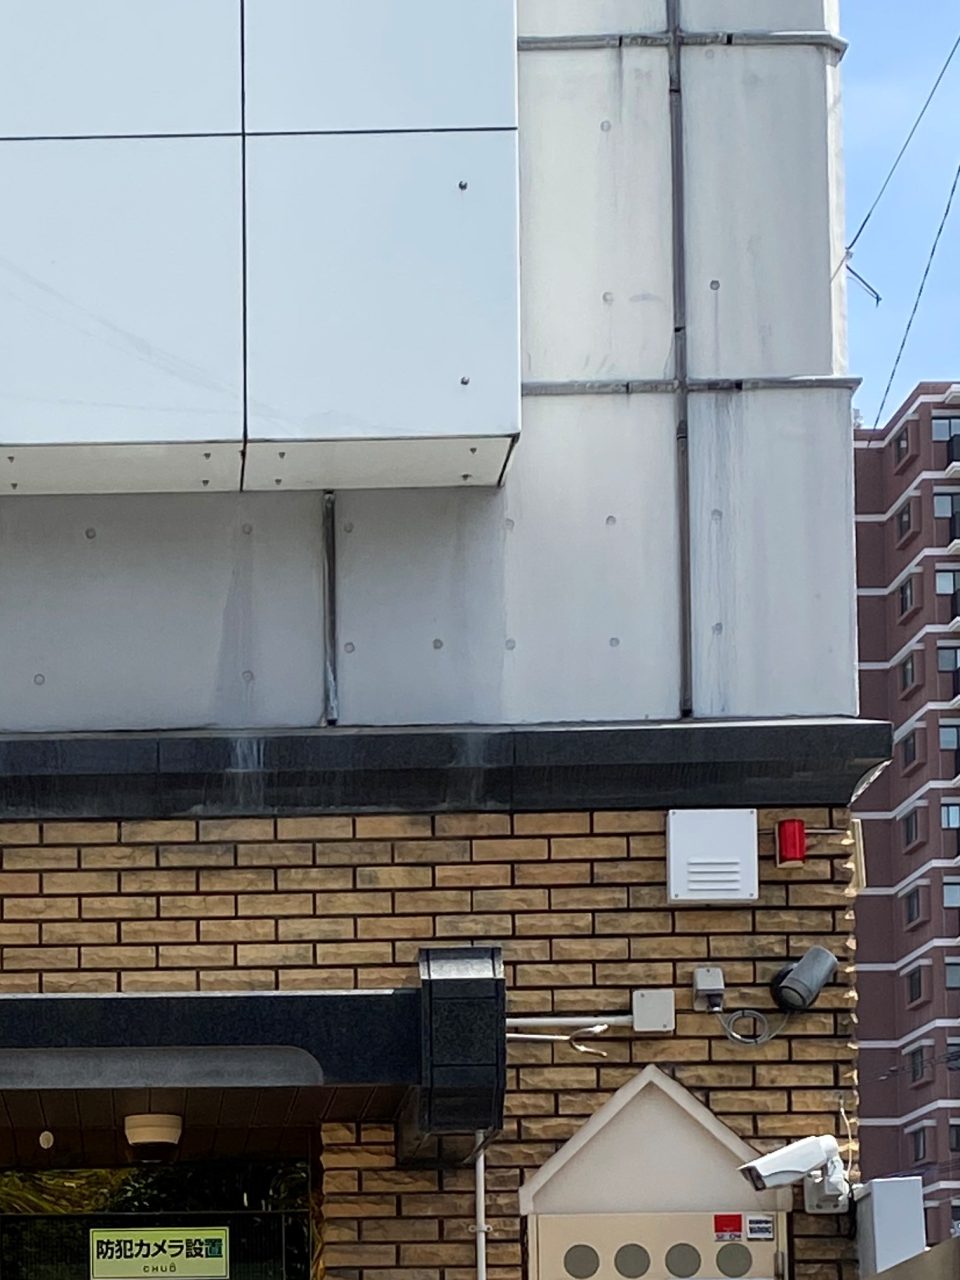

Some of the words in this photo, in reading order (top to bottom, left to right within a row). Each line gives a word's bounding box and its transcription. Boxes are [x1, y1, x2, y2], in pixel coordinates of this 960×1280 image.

[96, 1238, 223, 1259] 防犯カメラ設置
